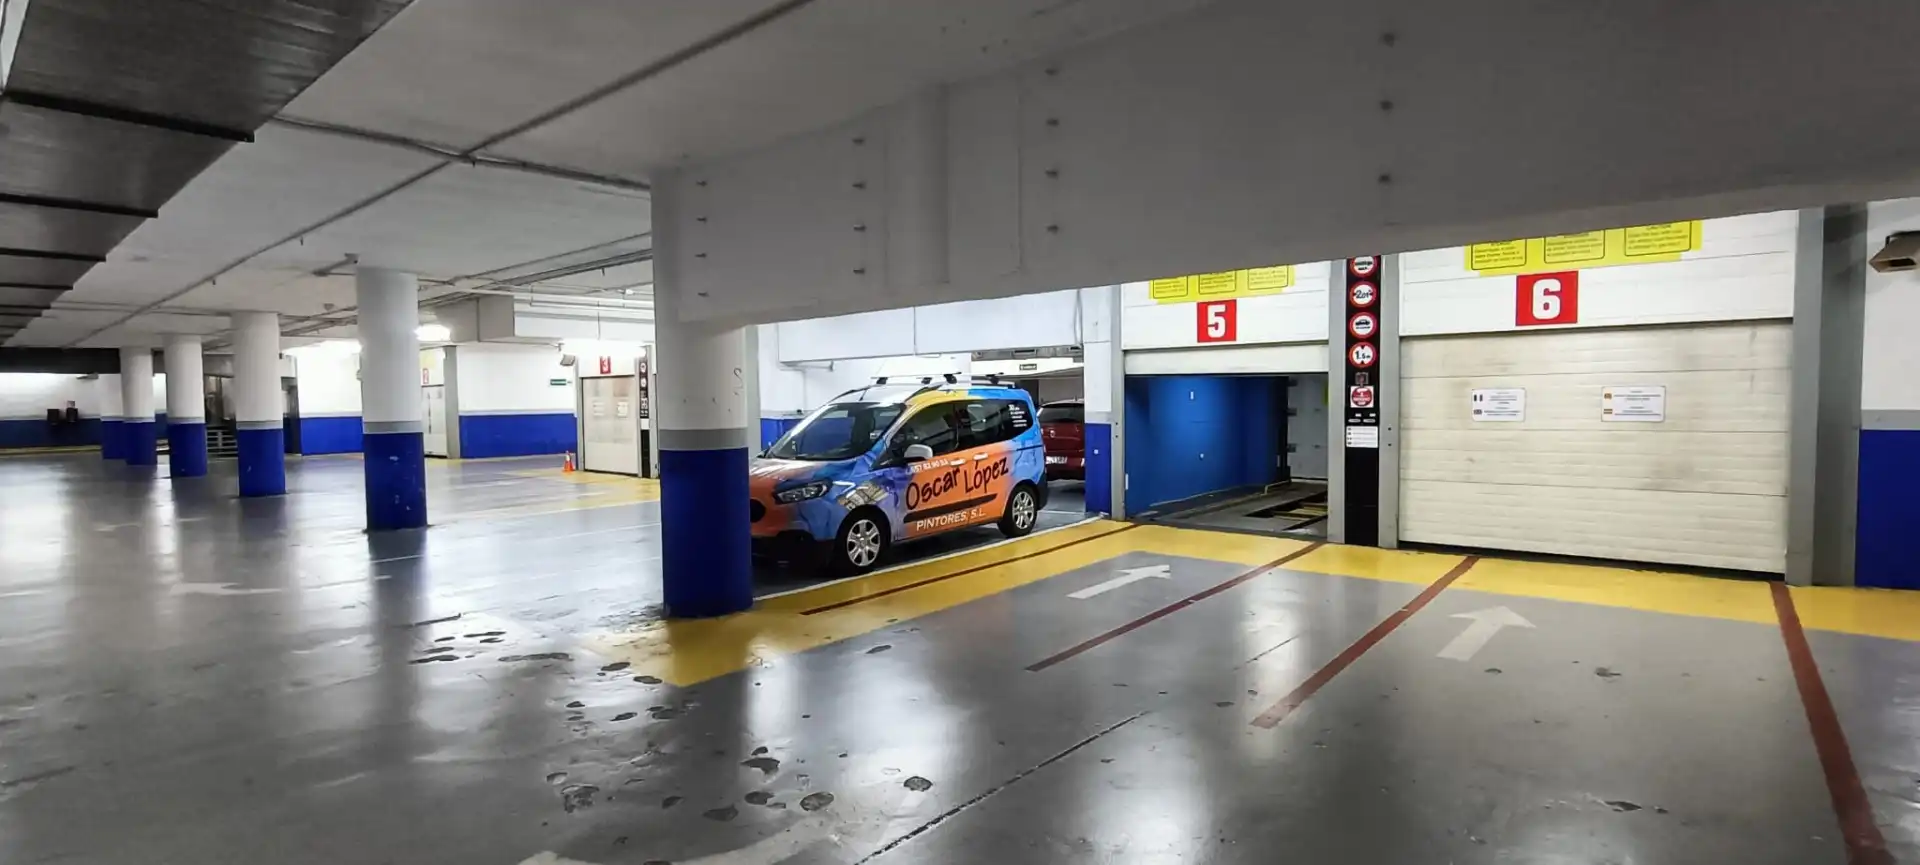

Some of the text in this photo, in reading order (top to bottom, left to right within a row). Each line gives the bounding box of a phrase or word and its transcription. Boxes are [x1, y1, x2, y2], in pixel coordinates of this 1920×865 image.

[1531, 277, 1562, 320] 6
[1207, 304, 1226, 338] 5
[601, 356, 609, 372] 3
[905, 458, 1009, 511] Oscar López
